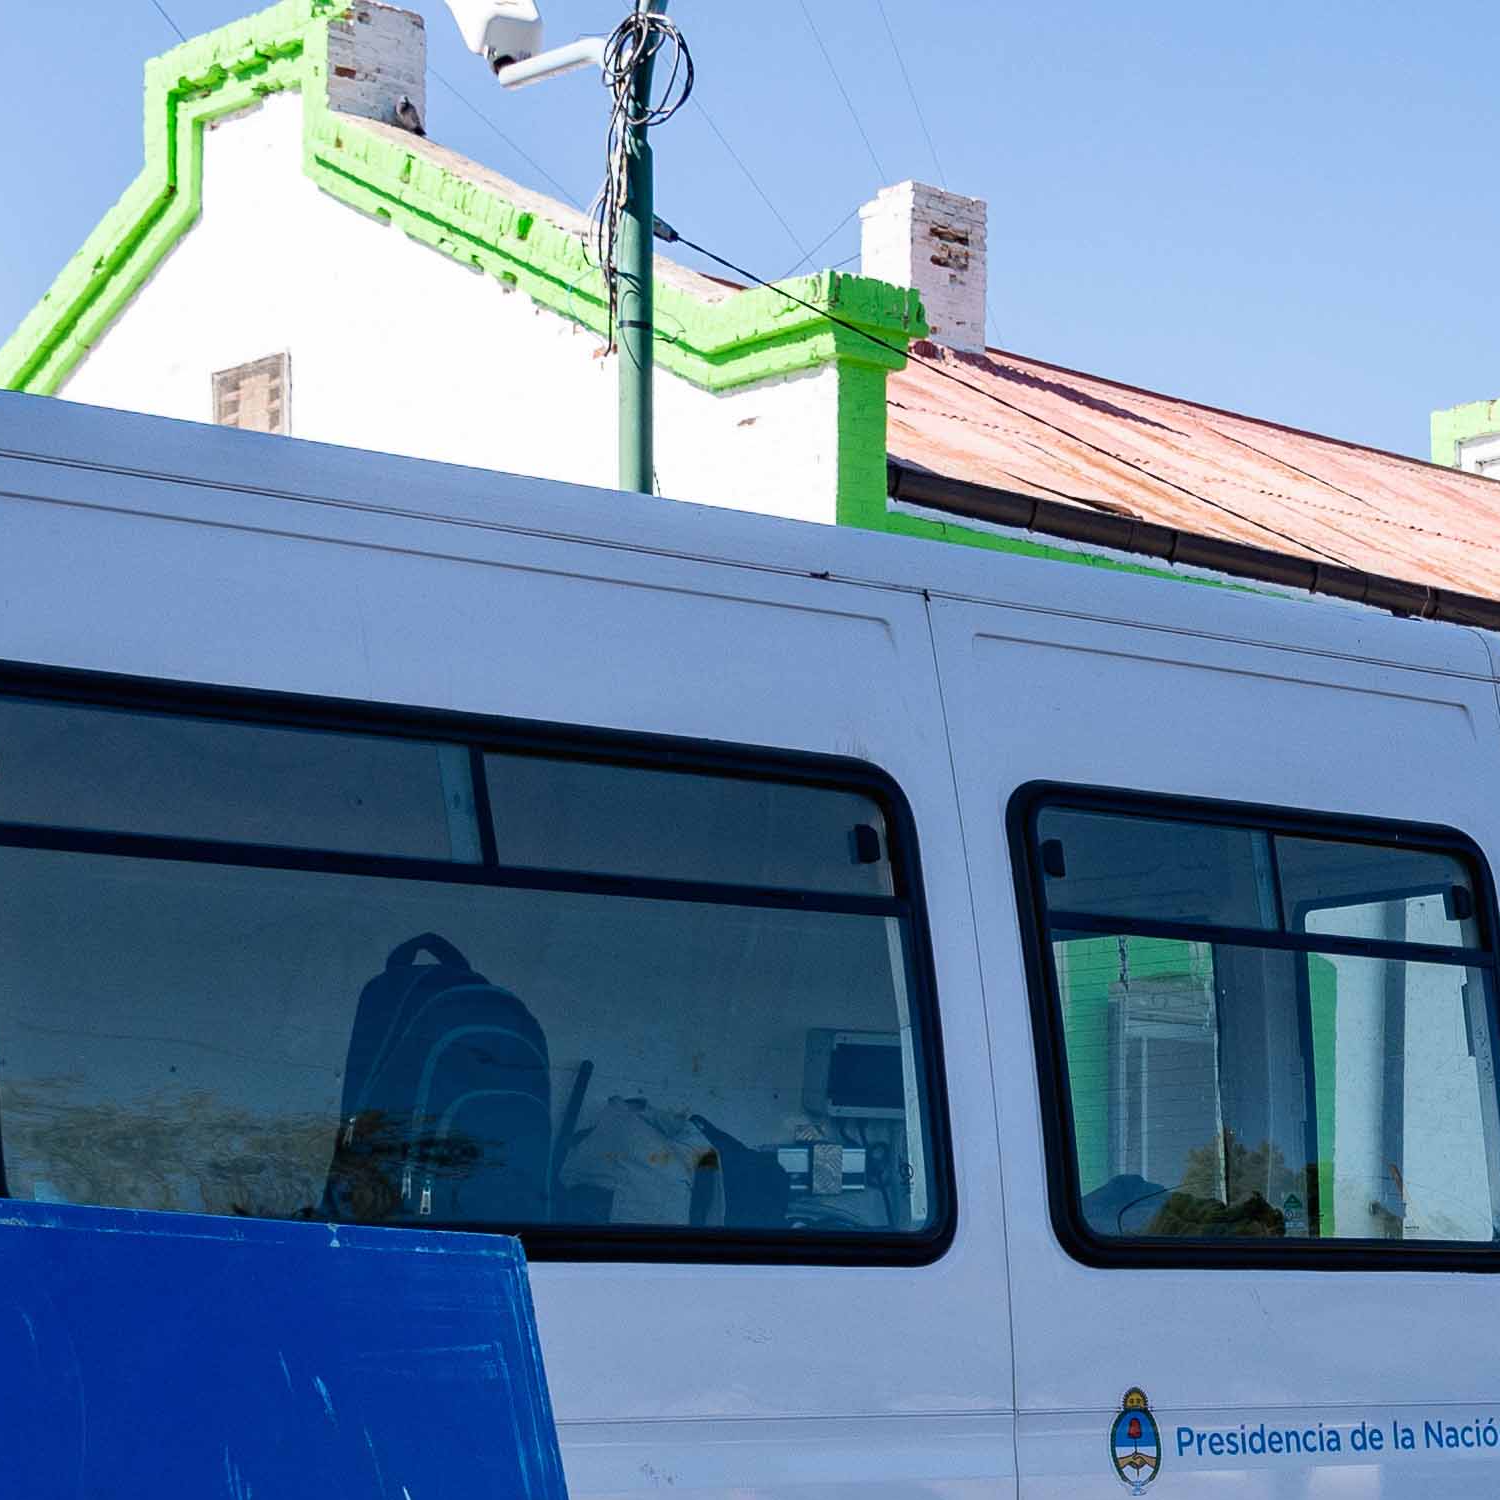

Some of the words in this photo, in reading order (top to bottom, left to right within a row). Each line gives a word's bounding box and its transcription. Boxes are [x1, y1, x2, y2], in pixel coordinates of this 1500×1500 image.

[1176, 1423, 1341, 1456] Presidencia
[1350, 1423, 1383, 1450] de
[1393, 1421, 1415, 1449] la
